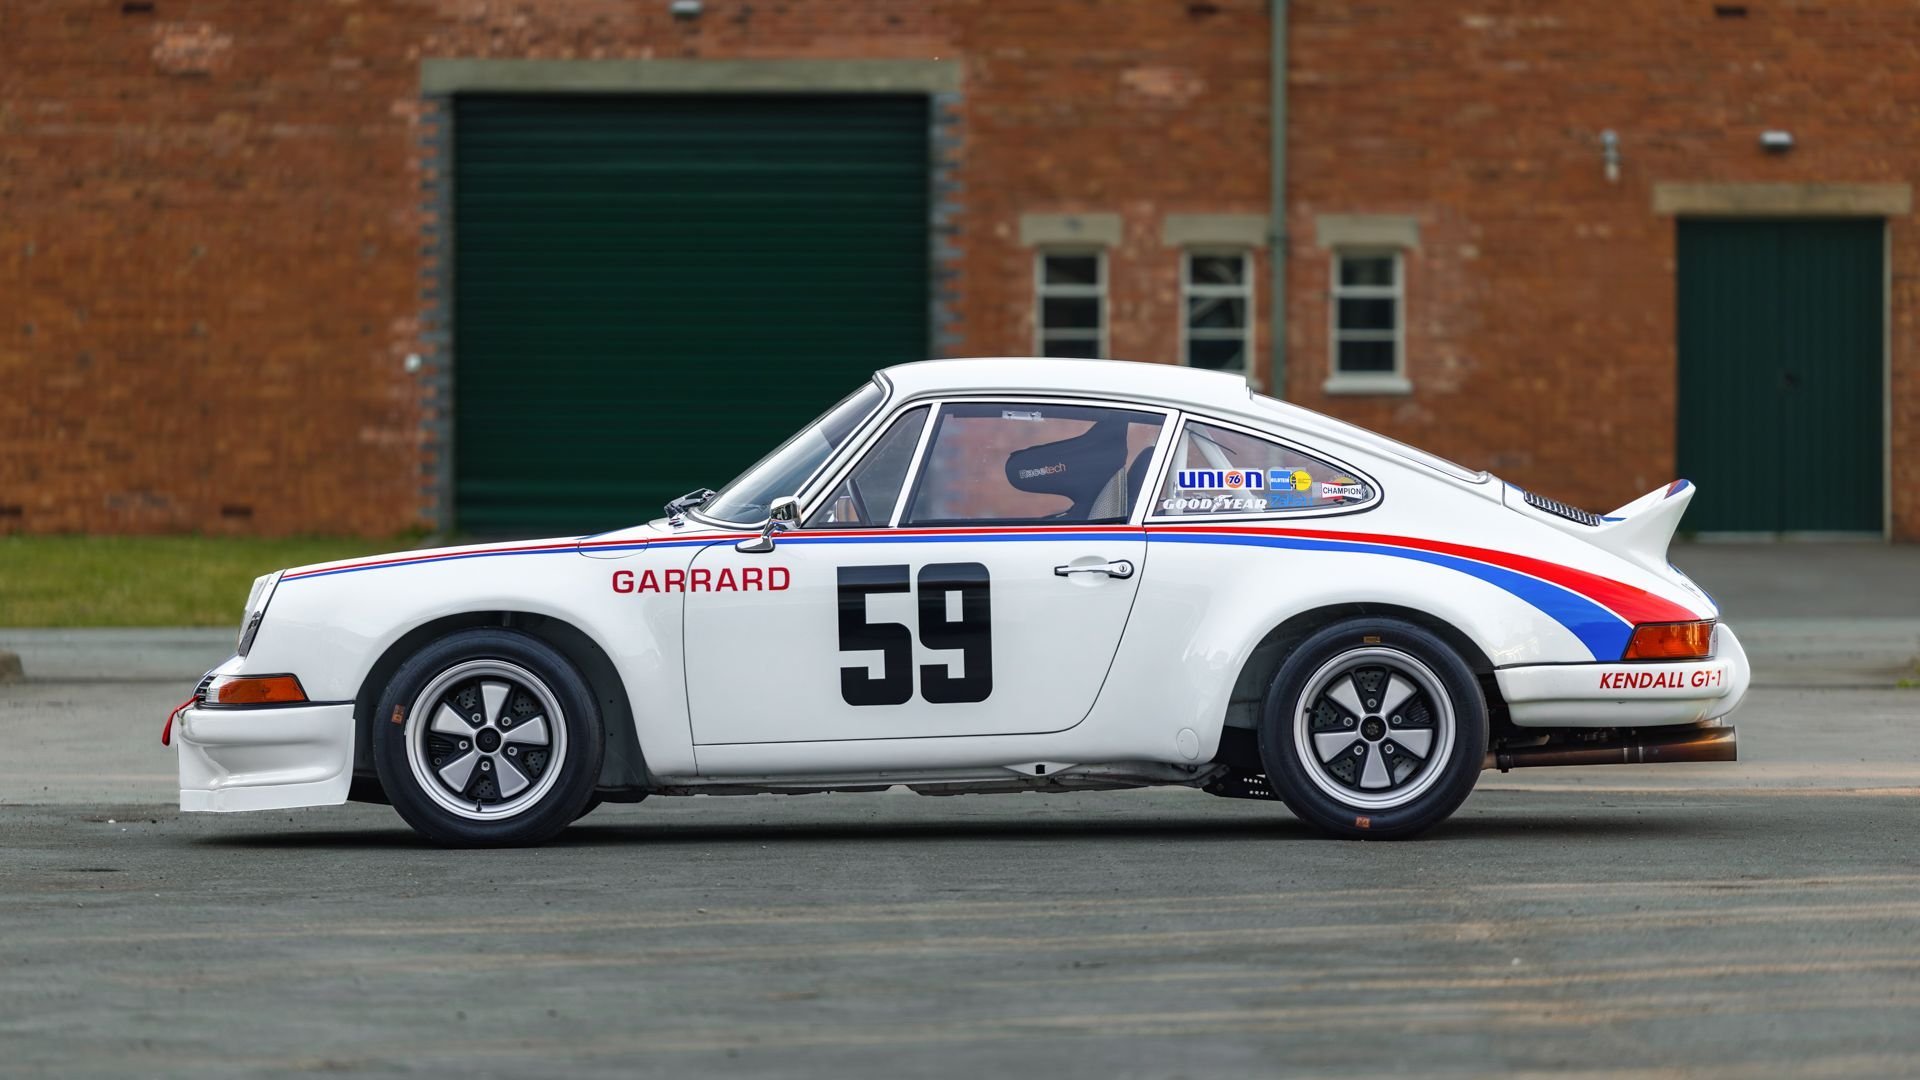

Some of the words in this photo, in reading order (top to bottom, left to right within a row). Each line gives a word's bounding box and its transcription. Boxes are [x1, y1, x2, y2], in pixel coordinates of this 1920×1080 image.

[1228, 475, 1241, 484] 76
[1322, 486, 1362, 495] CHAMPION
[611, 566, 791, 594] GARRARD
[836, 562, 993, 707] 59
[1599, 671, 1685, 689] KENDALL
[1691, 670, 1722, 688] GT-1
